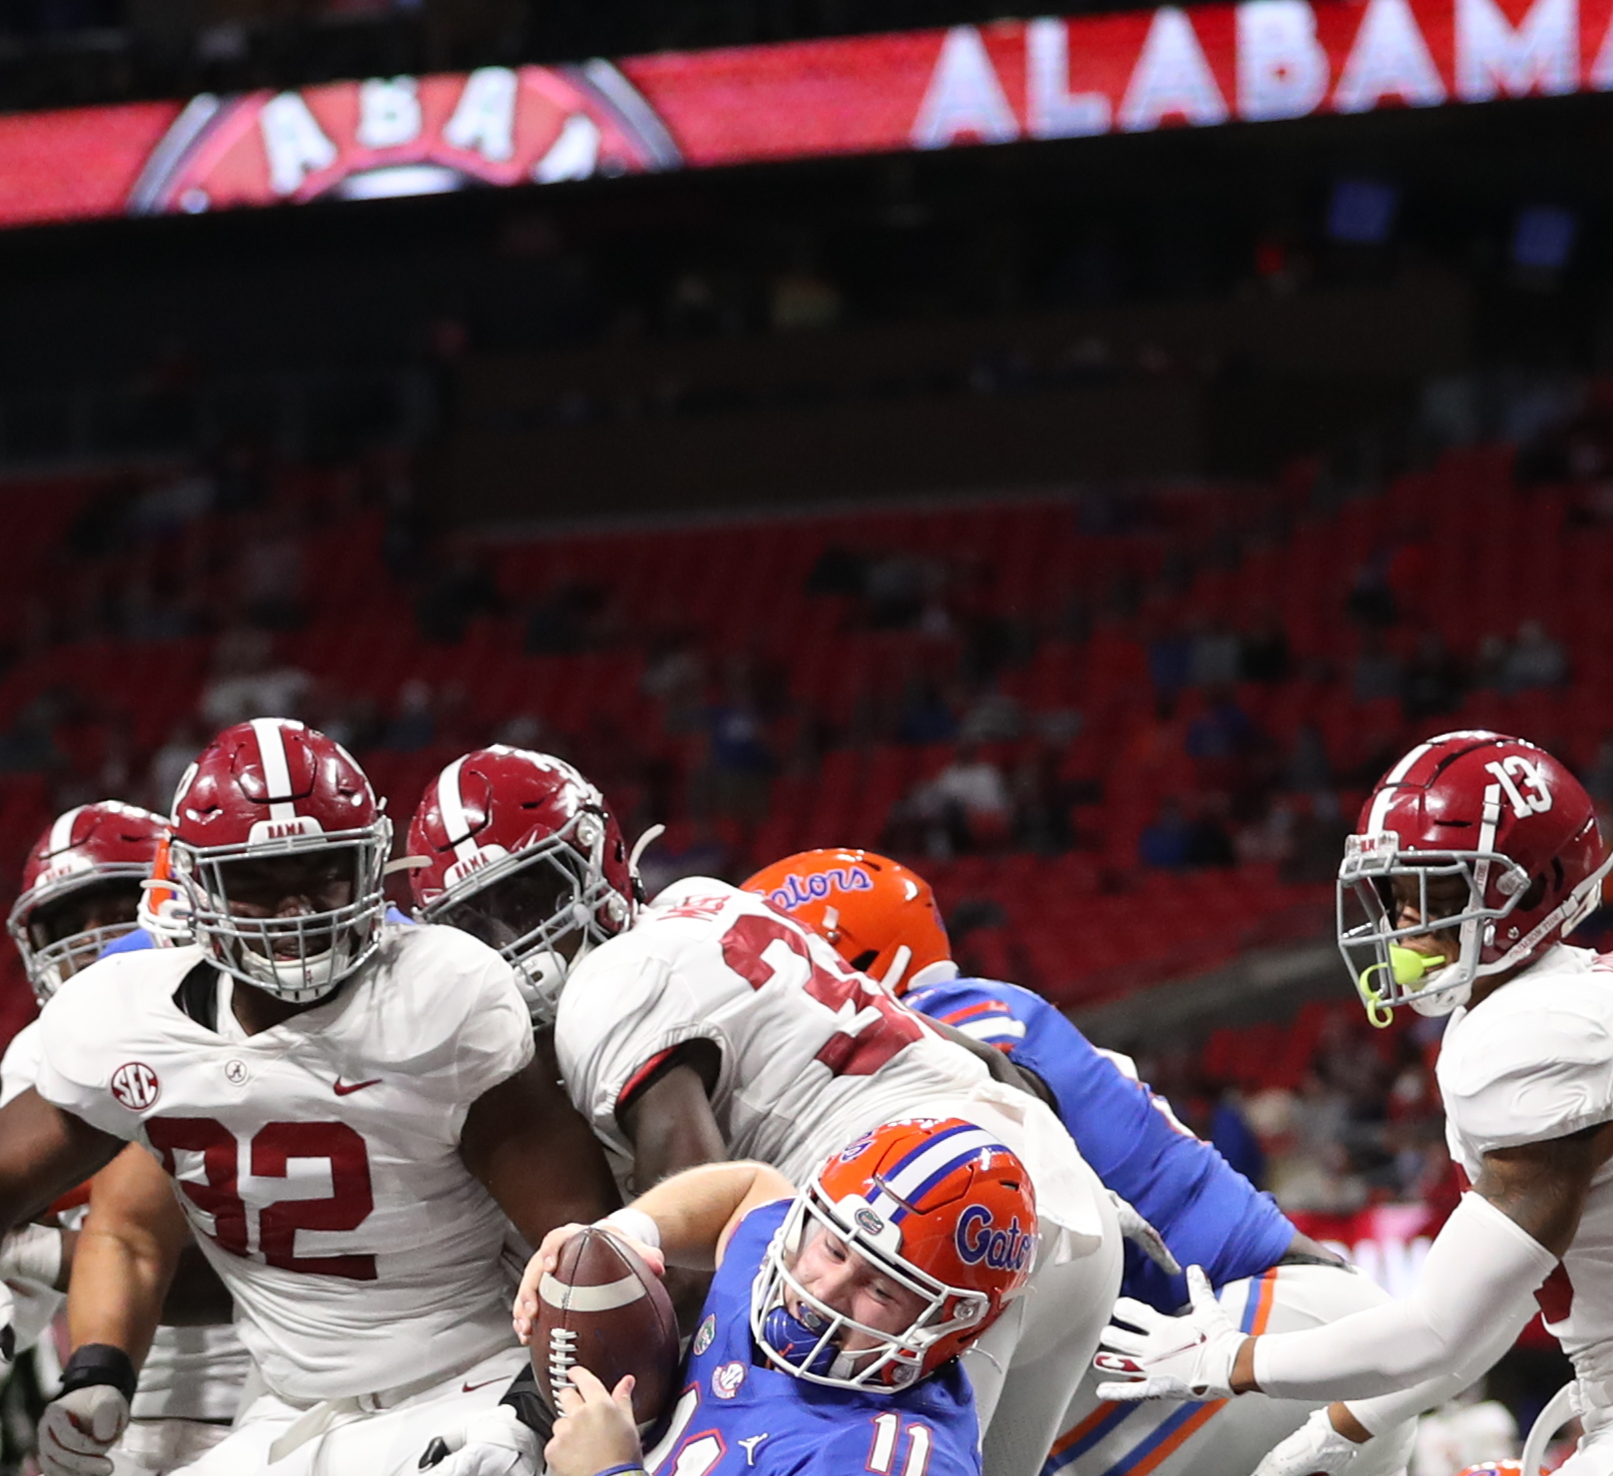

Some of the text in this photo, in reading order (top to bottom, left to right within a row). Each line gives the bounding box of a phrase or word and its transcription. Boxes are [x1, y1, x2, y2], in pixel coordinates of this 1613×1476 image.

[1484, 755, 1553, 819] 13
[753, 866, 872, 916] ators
[112, 1062, 159, 1110] SEC
[144, 1115, 378, 1282] 92
